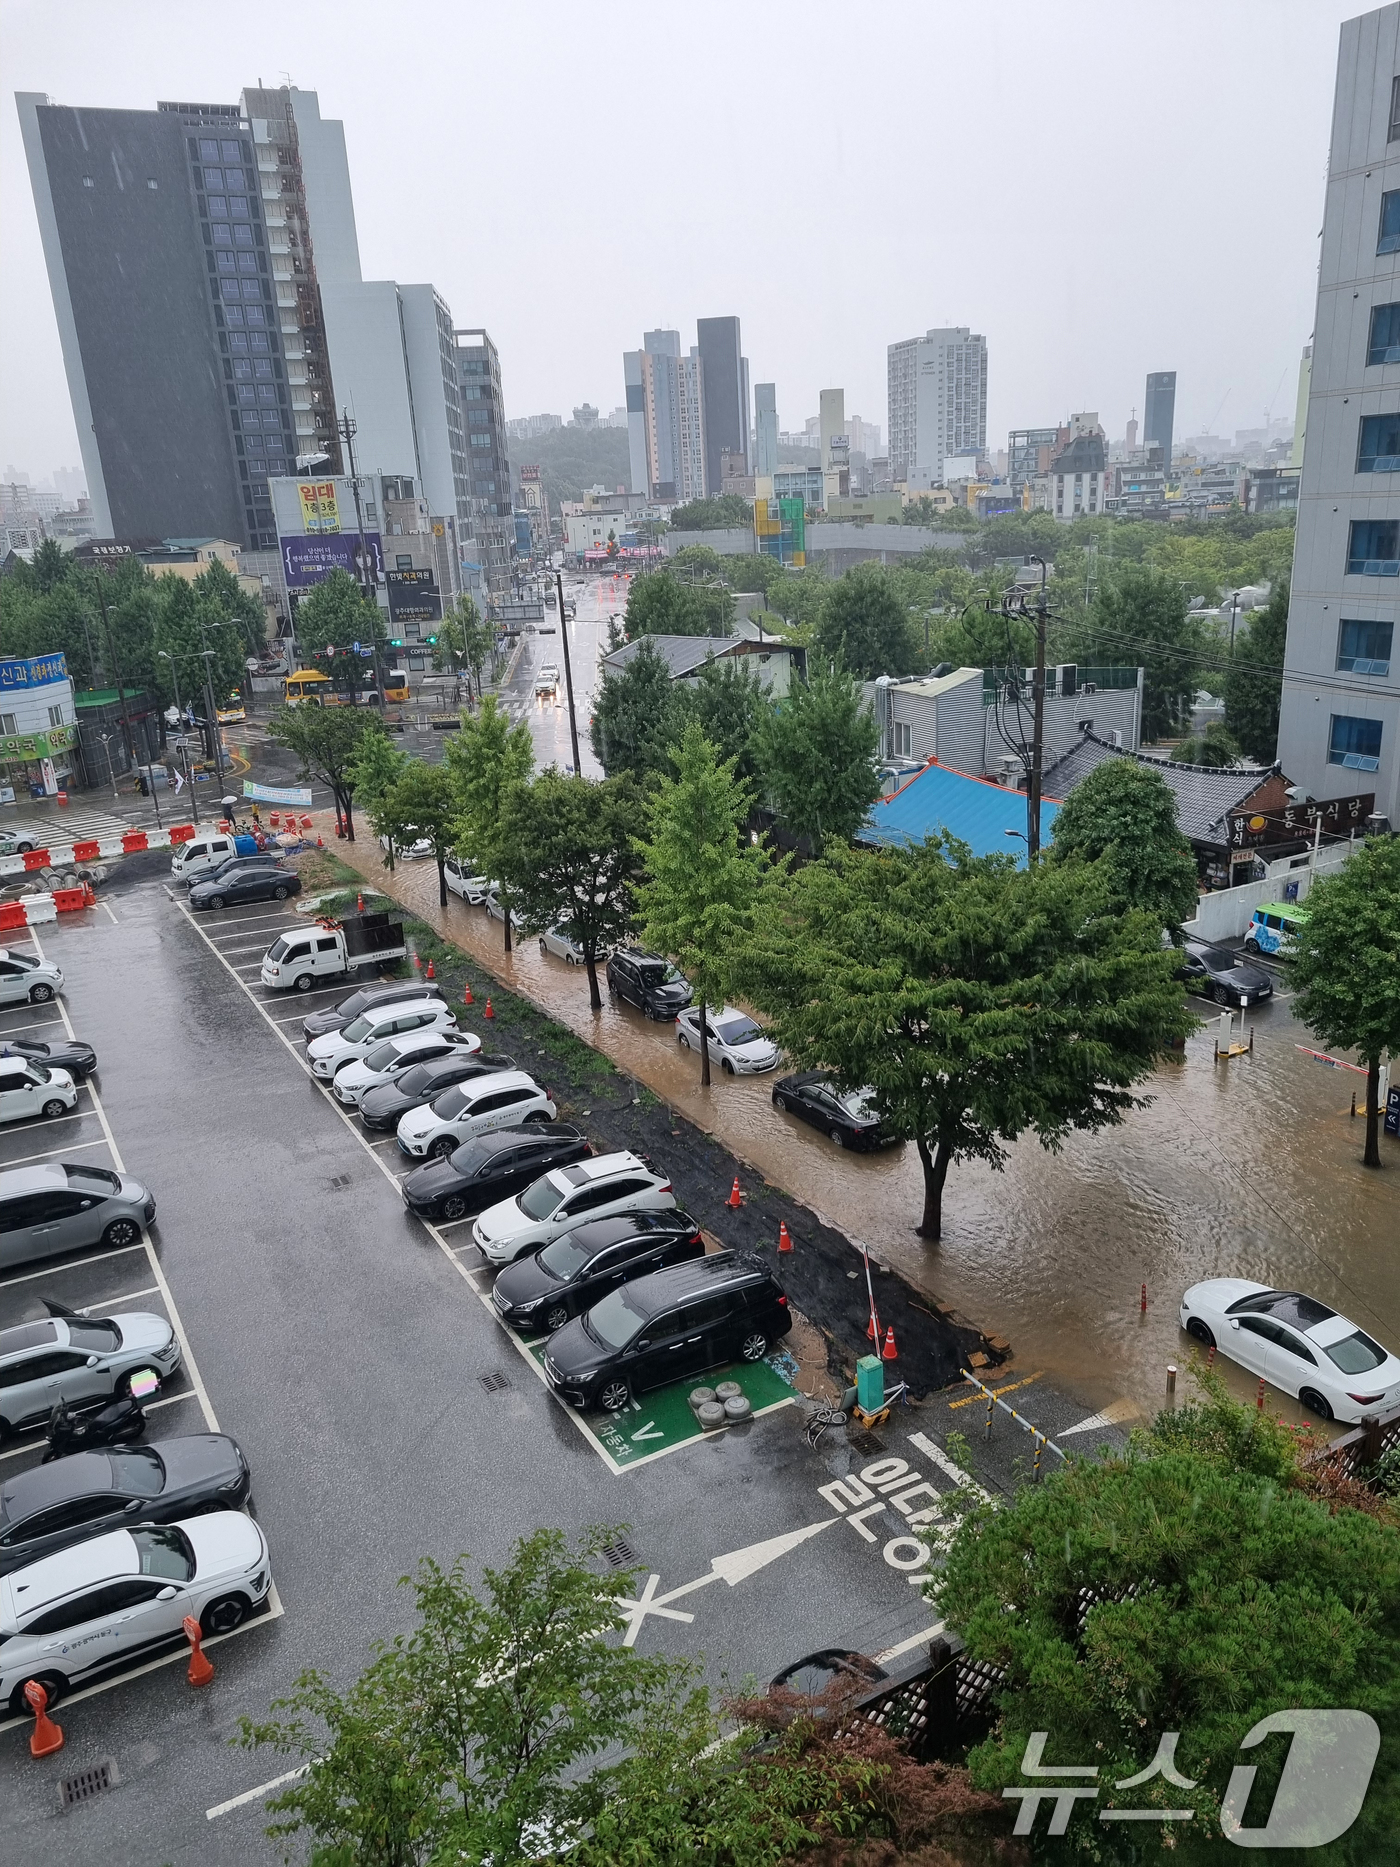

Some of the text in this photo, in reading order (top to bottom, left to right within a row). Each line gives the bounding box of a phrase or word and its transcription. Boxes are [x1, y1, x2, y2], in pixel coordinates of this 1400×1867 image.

[300, 483, 334, 501] 임대
[92, 545, 131, 554] 국제보청기
[50, 731, 68, 748] 약국
[1233, 818, 1245, 845] 한식
[1390, 1093, 1399, 1104] P
